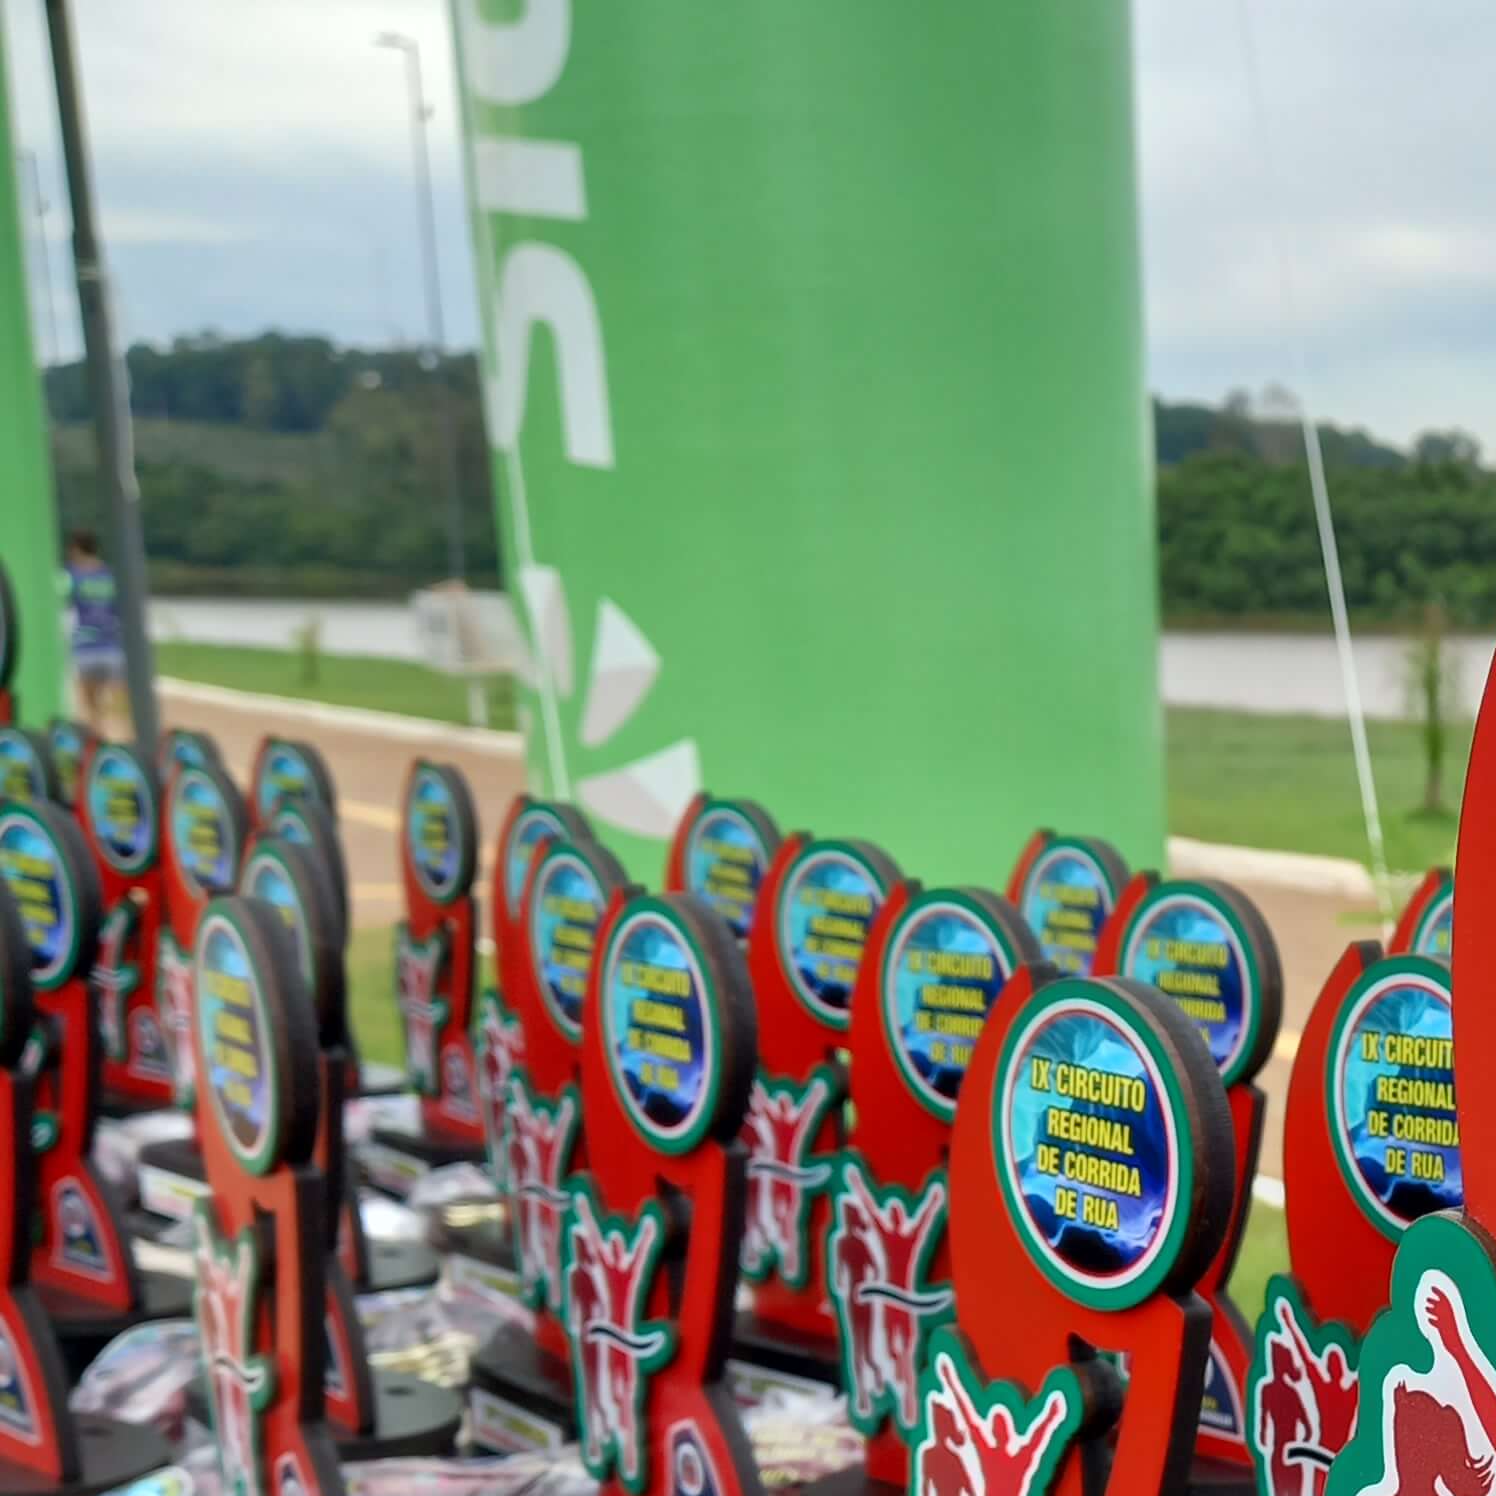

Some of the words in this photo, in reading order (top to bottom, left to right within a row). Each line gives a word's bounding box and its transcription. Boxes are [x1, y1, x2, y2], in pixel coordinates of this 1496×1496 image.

[1361, 1031, 1381, 1062] IX
[1384, 1034, 1455, 1071] CIRCUIT
[1030, 1056, 1051, 1091] IX
[1055, 1063, 1147, 1113] CIRCUITO
[1376, 1075, 1457, 1111] REGIONAL
[1046, 1107, 1135, 1156] REGIONAL
[1367, 1110, 1389, 1137] DE
[1036, 1143, 1060, 1175] DE
[1063, 1151, 1142, 1197] CORRIDA
[1384, 1146, 1405, 1176] DE
[1411, 1151, 1445, 1181] RUA
[1053, 1187, 1077, 1219] DE
[1082, 1195, 1120, 1233] RUA
